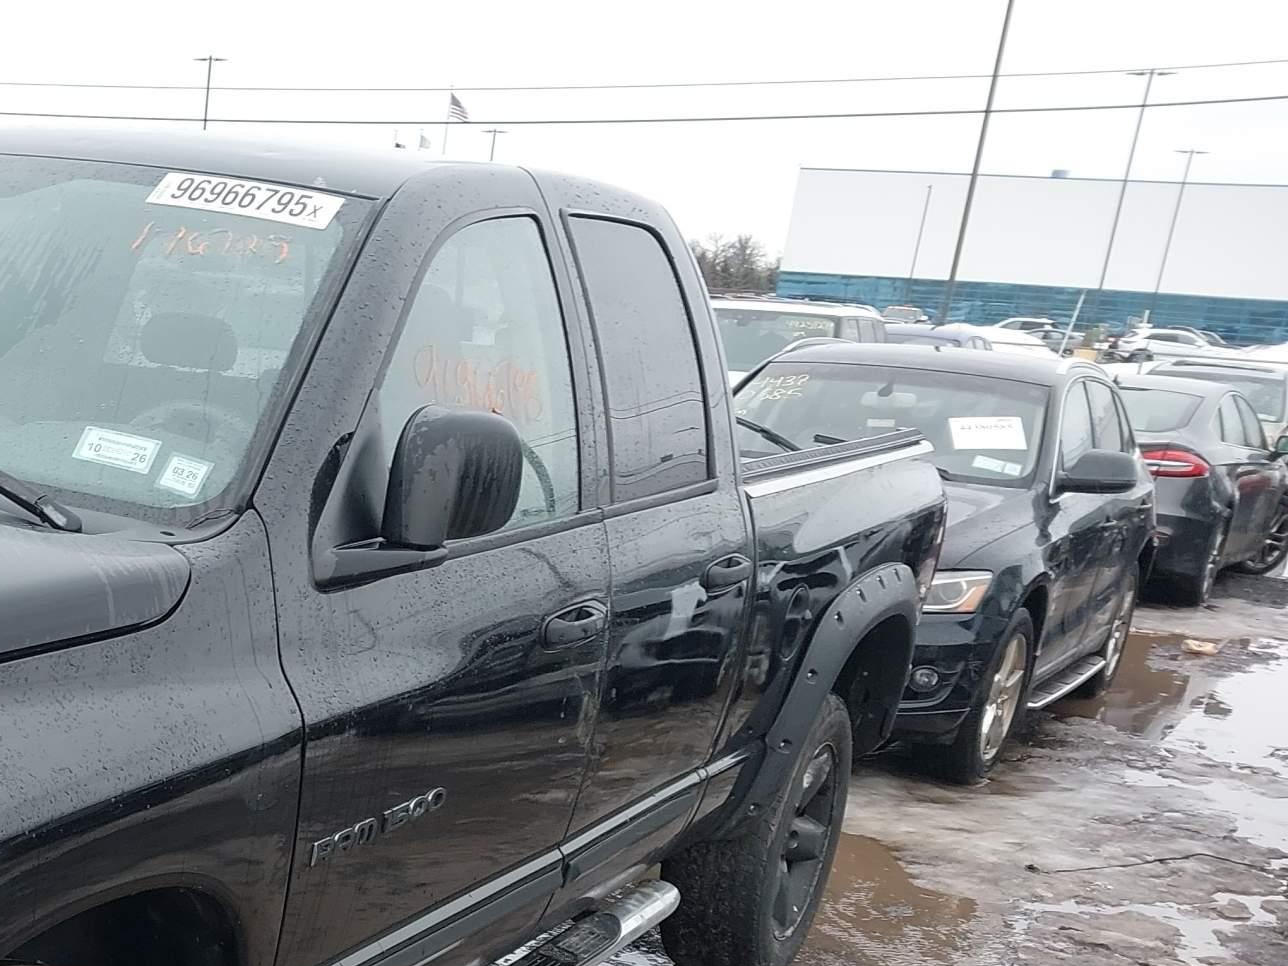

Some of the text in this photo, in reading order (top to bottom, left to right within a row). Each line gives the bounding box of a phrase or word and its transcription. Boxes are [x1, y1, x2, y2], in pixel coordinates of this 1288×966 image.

[87, 442, 103, 453] 10
[131, 452, 148, 464] 26
[380, 786, 447, 833] 1500
